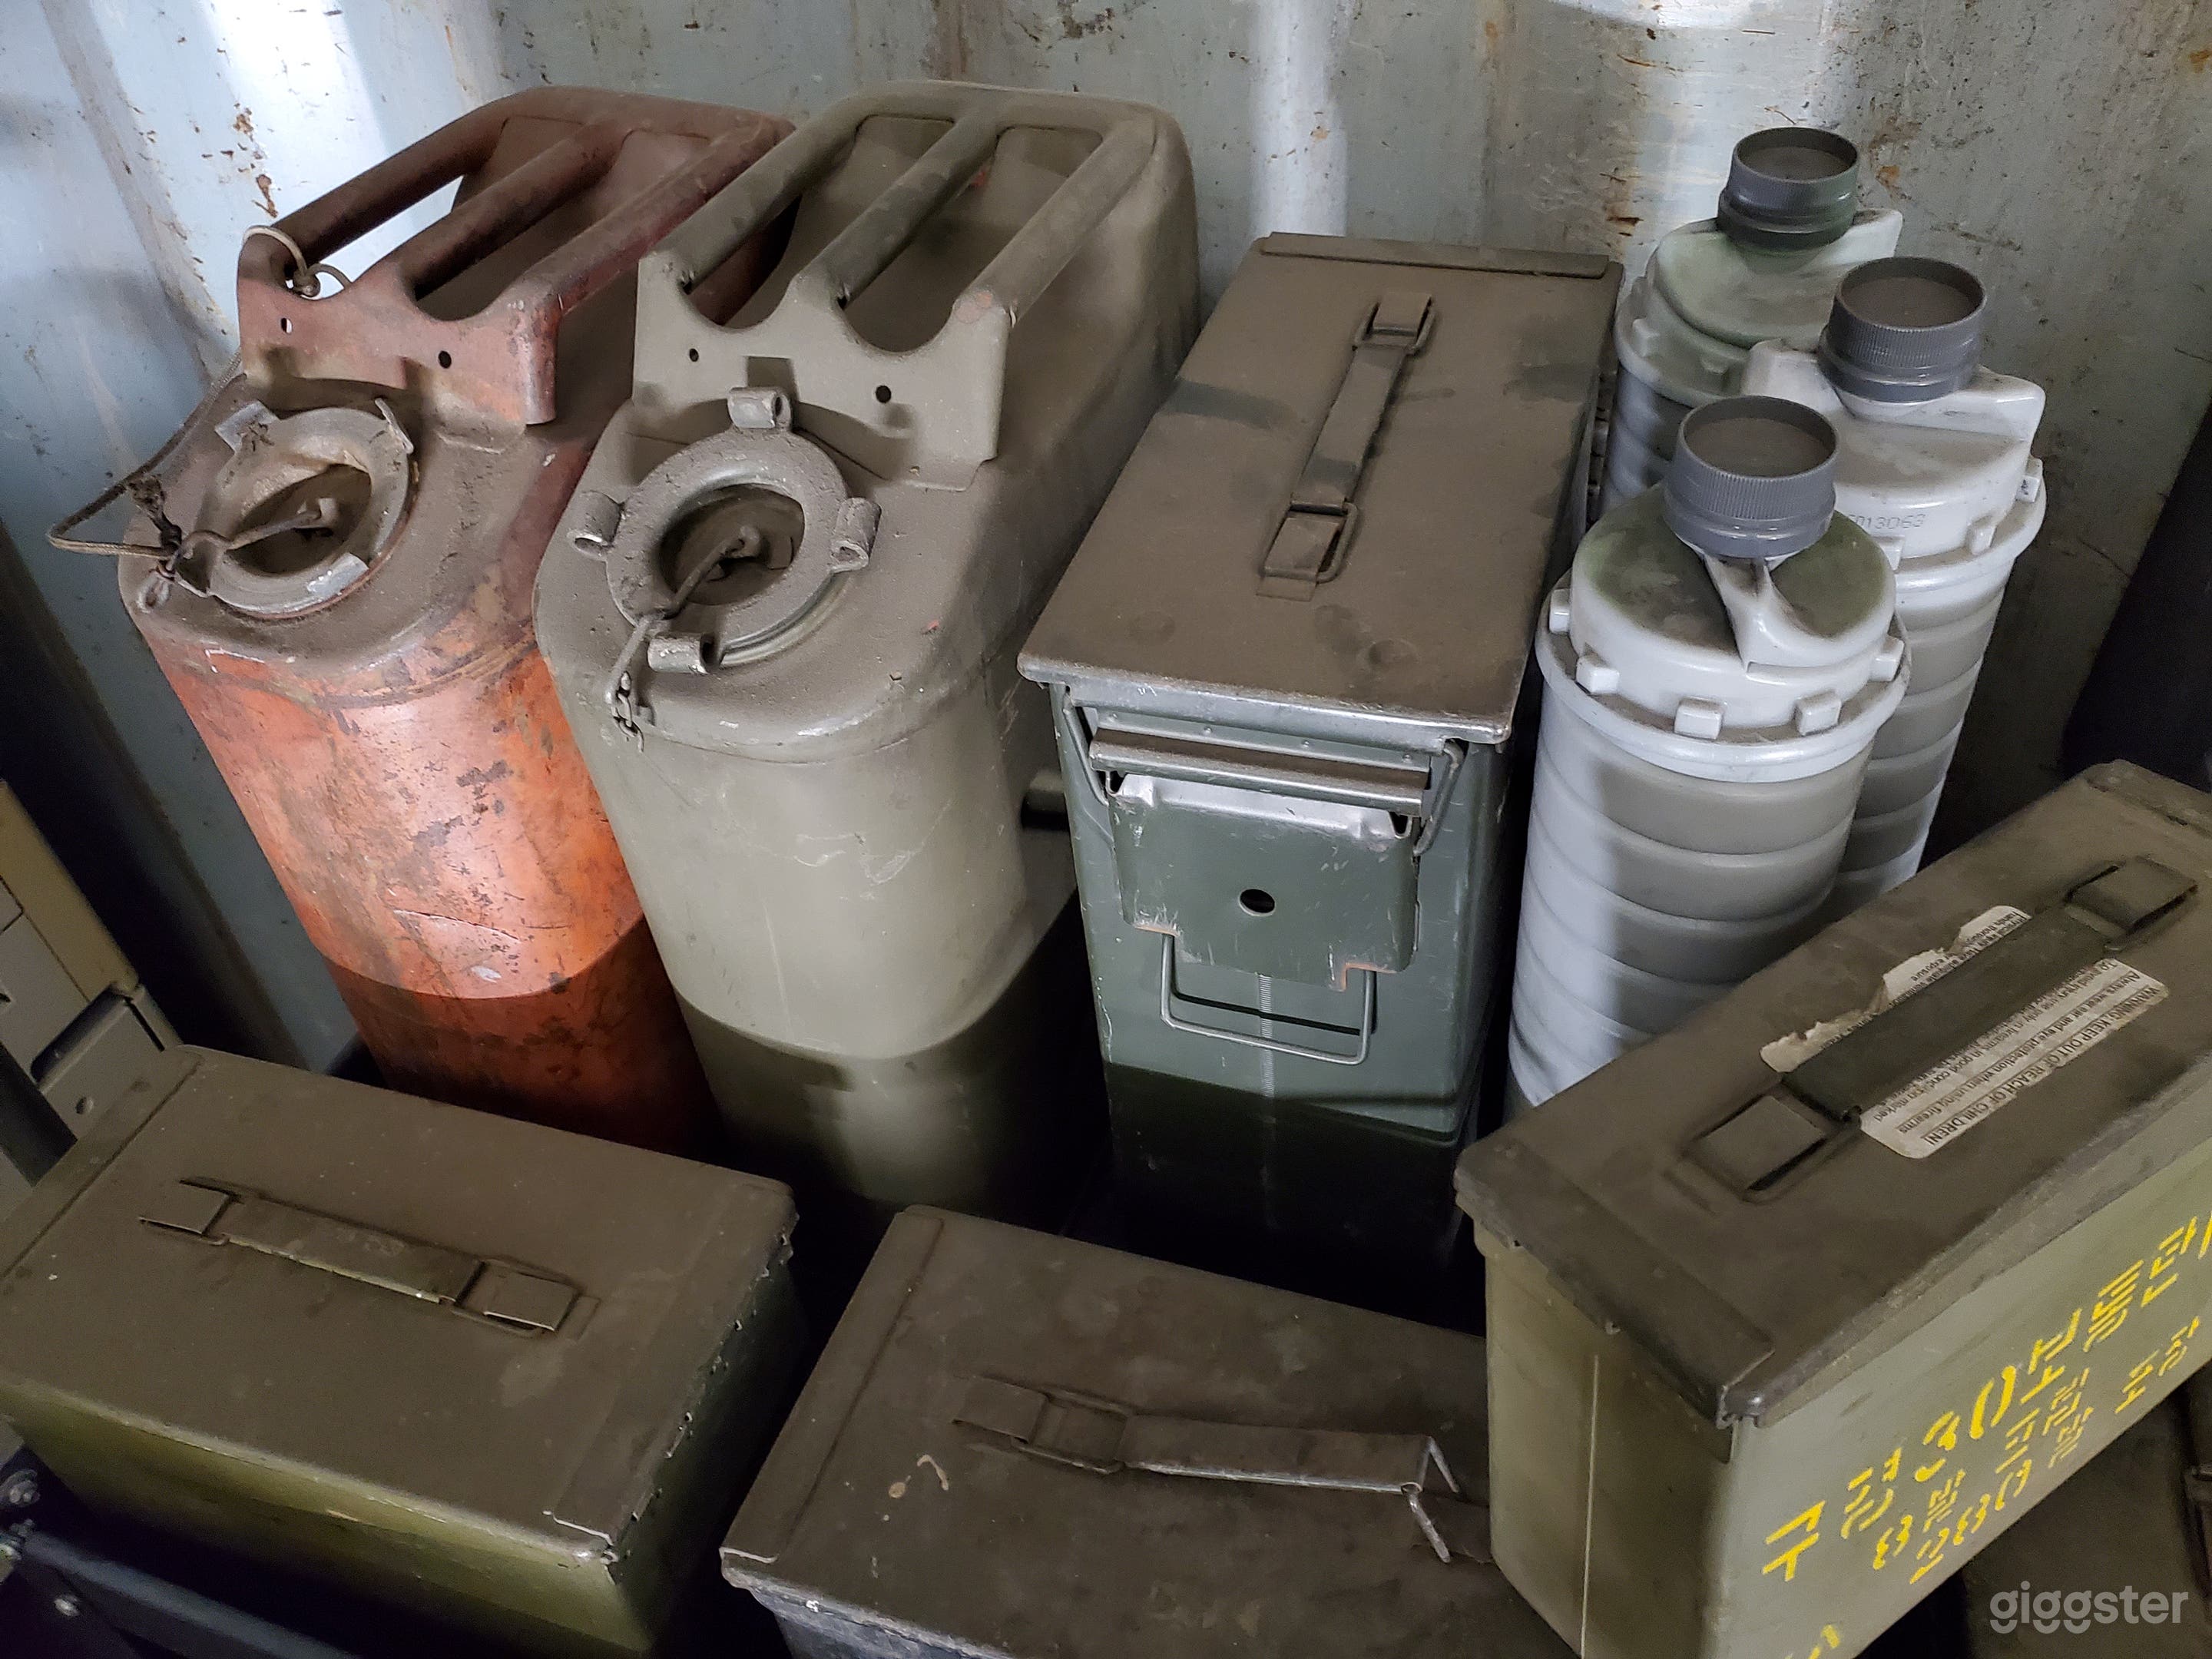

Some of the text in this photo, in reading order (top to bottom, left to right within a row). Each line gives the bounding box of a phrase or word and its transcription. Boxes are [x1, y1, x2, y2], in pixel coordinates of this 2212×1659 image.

[1909, 957, 1945, 981] exposure
[2103, 970, 2141, 996] Always
[2035, 1026, 2058, 1041] eye
[2052, 1015, 2076, 1031] and
[2077, 1018, 2111, 1041] KEEP
[1988, 1038, 2043, 1074] protection
[2055, 1037, 2085, 1057] OUT
[1946, 1054, 1976, 1075] good
[2039, 1052, 2061, 1068] OF
[1906, 1070, 1952, 1101] condon
[1965, 1069, 1998, 1091] when
[2001, 1064, 2045, 1094] REACH
[1985, 1089, 2008, 1105] OF
[1898, 1105, 1943, 1136] firearms
[1763, 1209, 2212, 1581] 구경30보통탄
